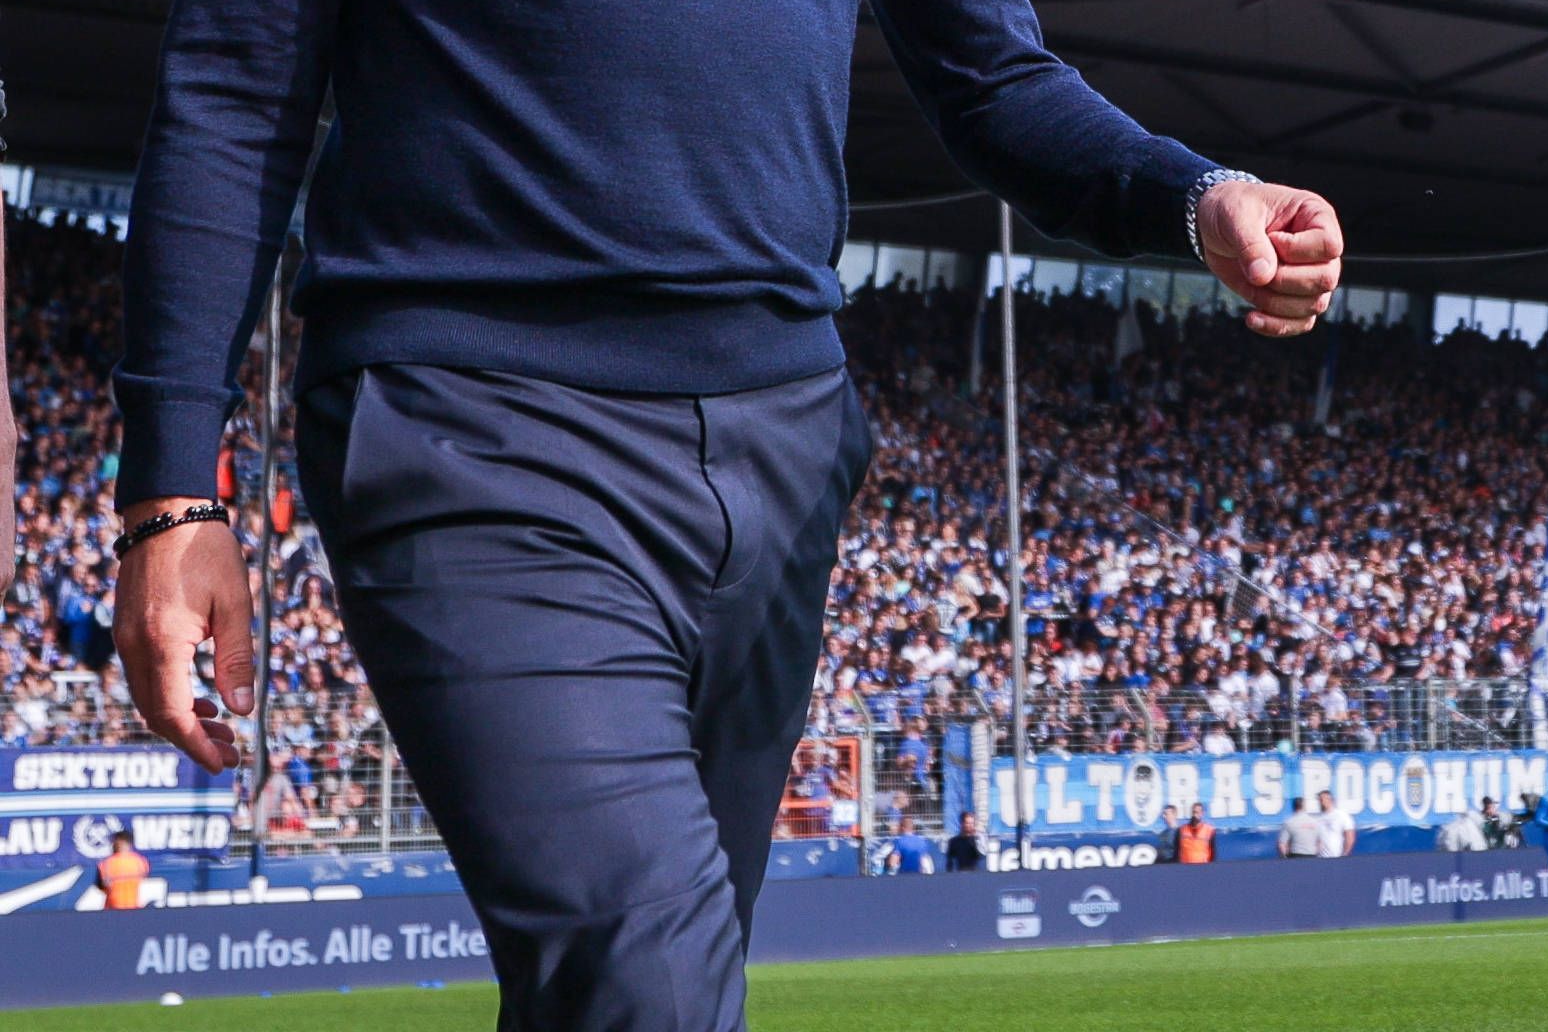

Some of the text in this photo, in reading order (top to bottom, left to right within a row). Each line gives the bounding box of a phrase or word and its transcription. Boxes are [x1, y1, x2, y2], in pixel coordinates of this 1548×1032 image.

[13, 752, 180, 790] SEKTION
[0, 817, 63, 856] AU
[1379, 876, 1422, 907] Alle
[1428, 871, 1489, 904] Infos.
[1492, 872, 1534, 900] Alle
[137, 934, 211, 975] Alle
[218, 928, 318, 971] Infos.
[323, 925, 393, 965] Alle
